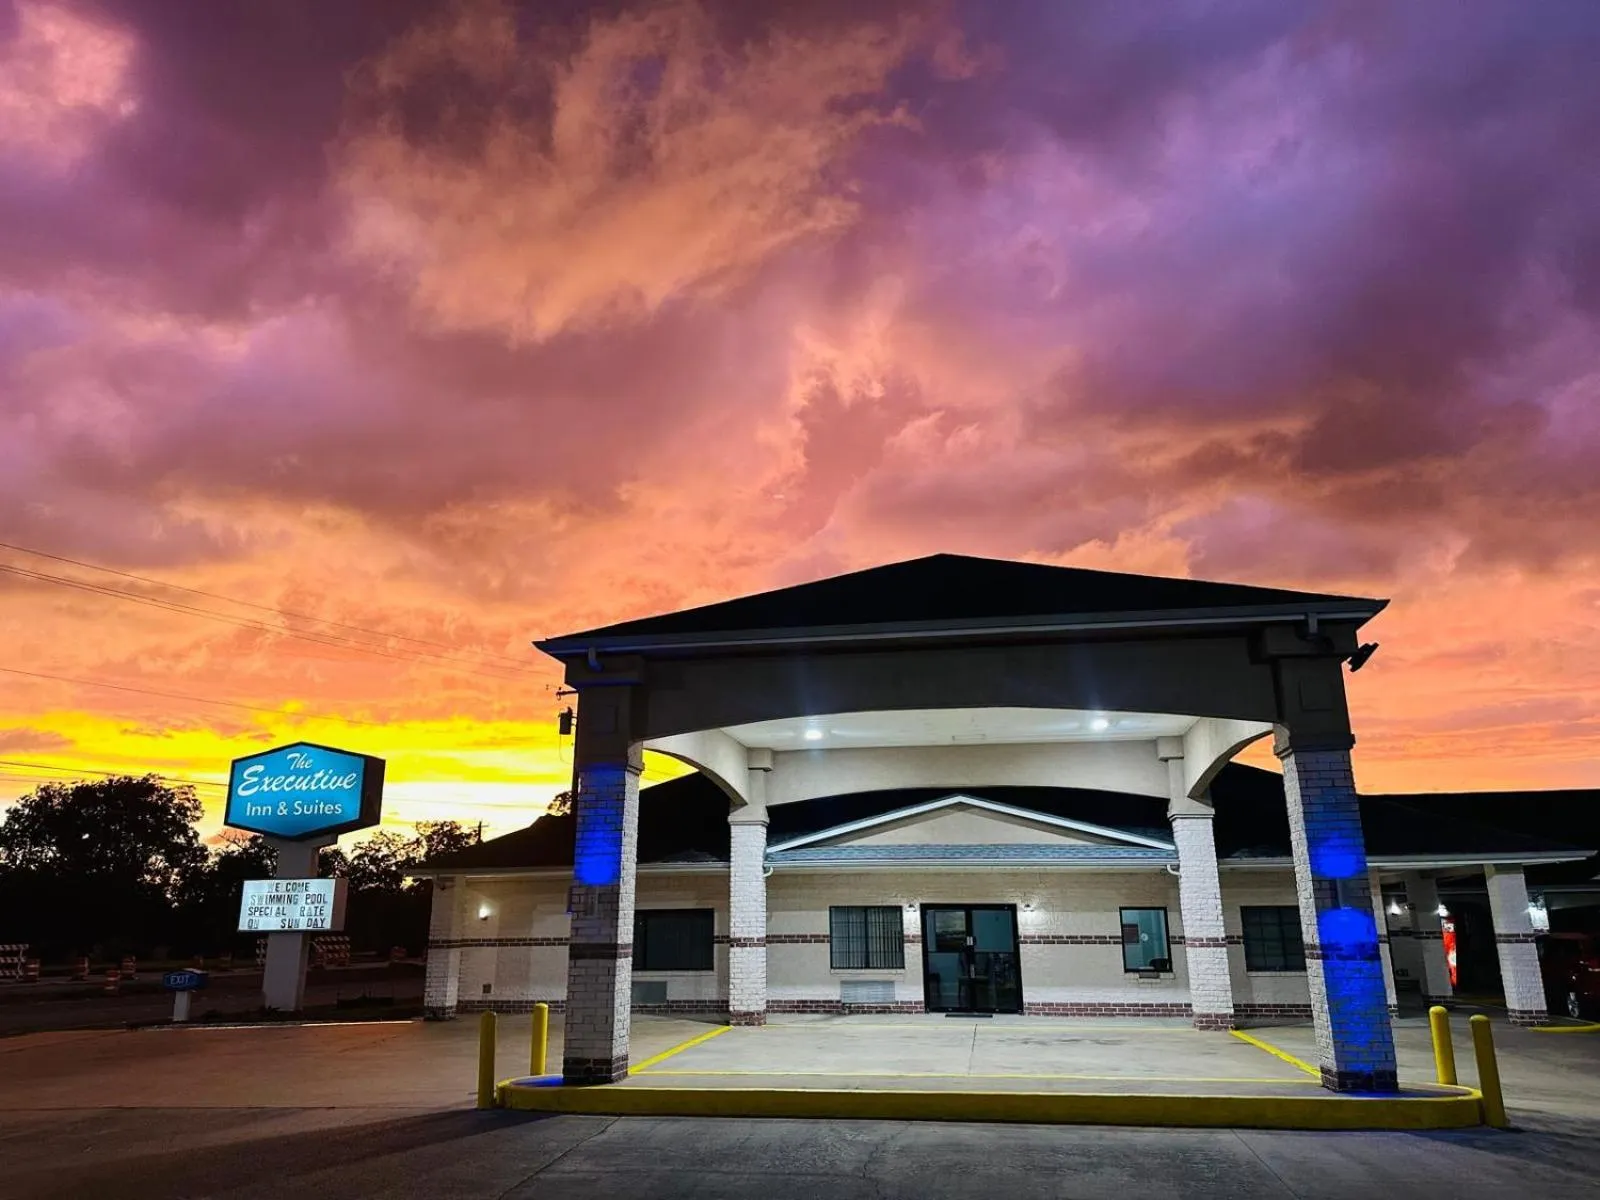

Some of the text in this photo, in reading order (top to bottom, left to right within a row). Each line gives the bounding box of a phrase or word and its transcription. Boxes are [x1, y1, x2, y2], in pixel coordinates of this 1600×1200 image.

[287, 752, 312, 770] The
[238, 765, 356, 796] Executive
[246, 800, 342, 816] Inn & Suites
[269, 882, 310, 893] ECOME
[250, 893, 328, 906] SWIMMING POOL
[300, 906, 325, 917] RATE
[248, 919, 260, 929] ON
[170, 975, 190, 985] EXIT
